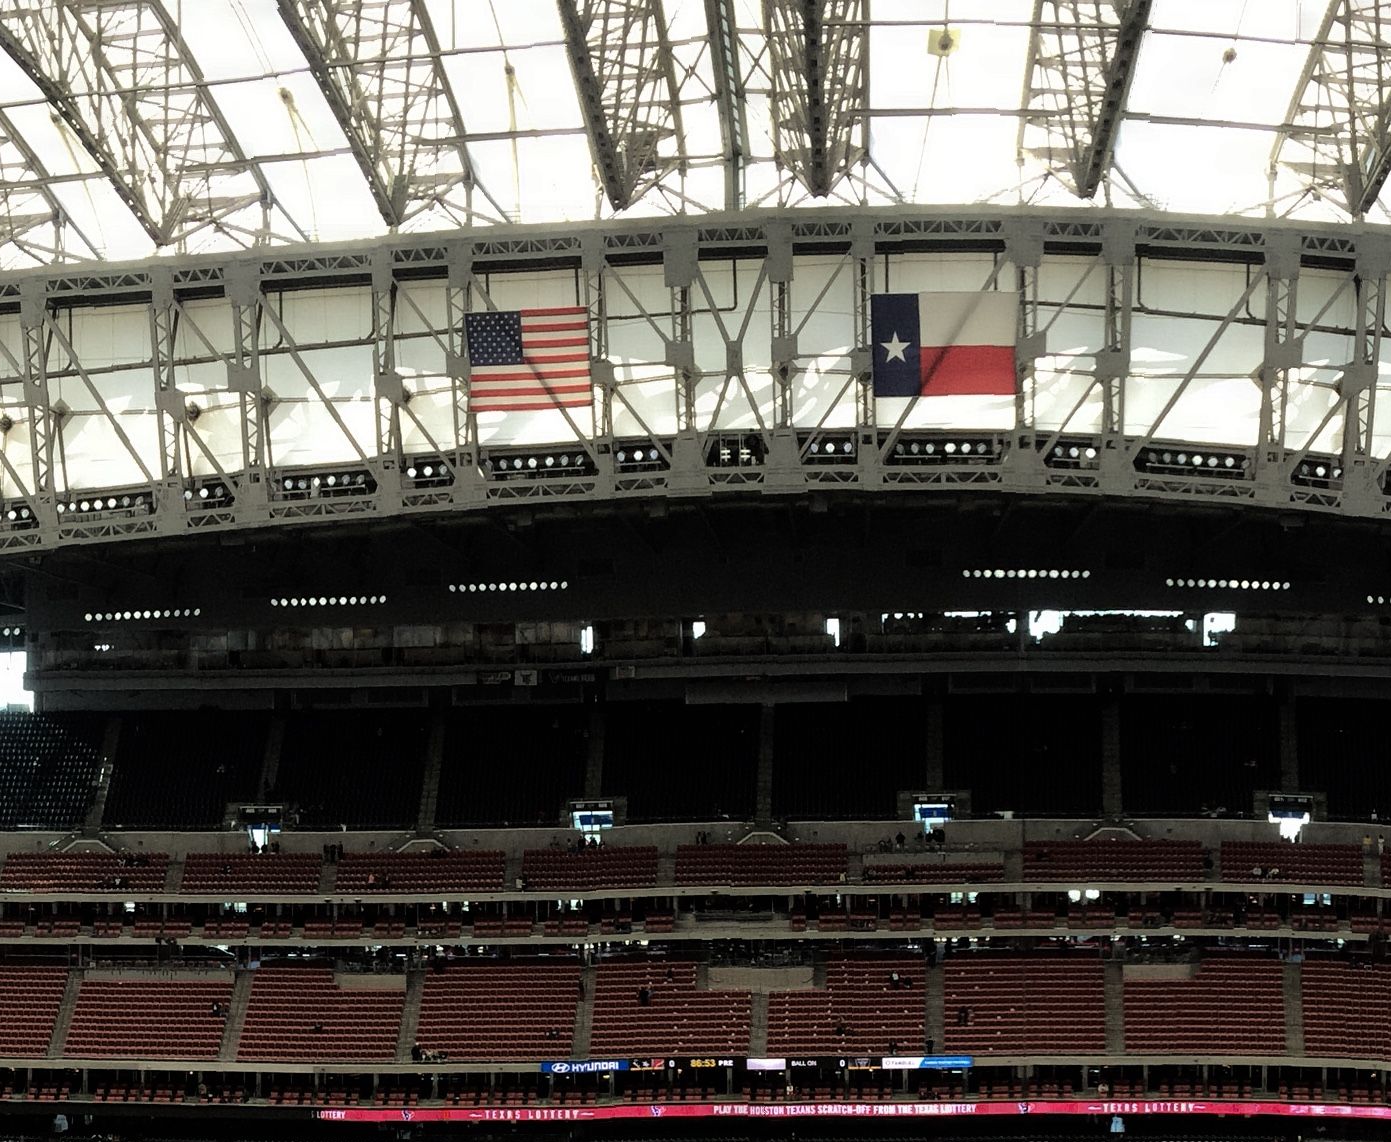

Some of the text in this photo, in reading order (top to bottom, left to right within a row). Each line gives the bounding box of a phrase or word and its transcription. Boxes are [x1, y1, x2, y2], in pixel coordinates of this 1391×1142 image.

[571, 1061, 619, 1072] HYUNDAI
[316, 1110, 345, 1119] LOTTERY
[528, 1110, 580, 1120] LOTTERY
[713, 1105, 733, 1114] PLAY
[750, 1106, 784, 1115] HOUSTON
[785, 1105, 816, 1115] TEXANS
